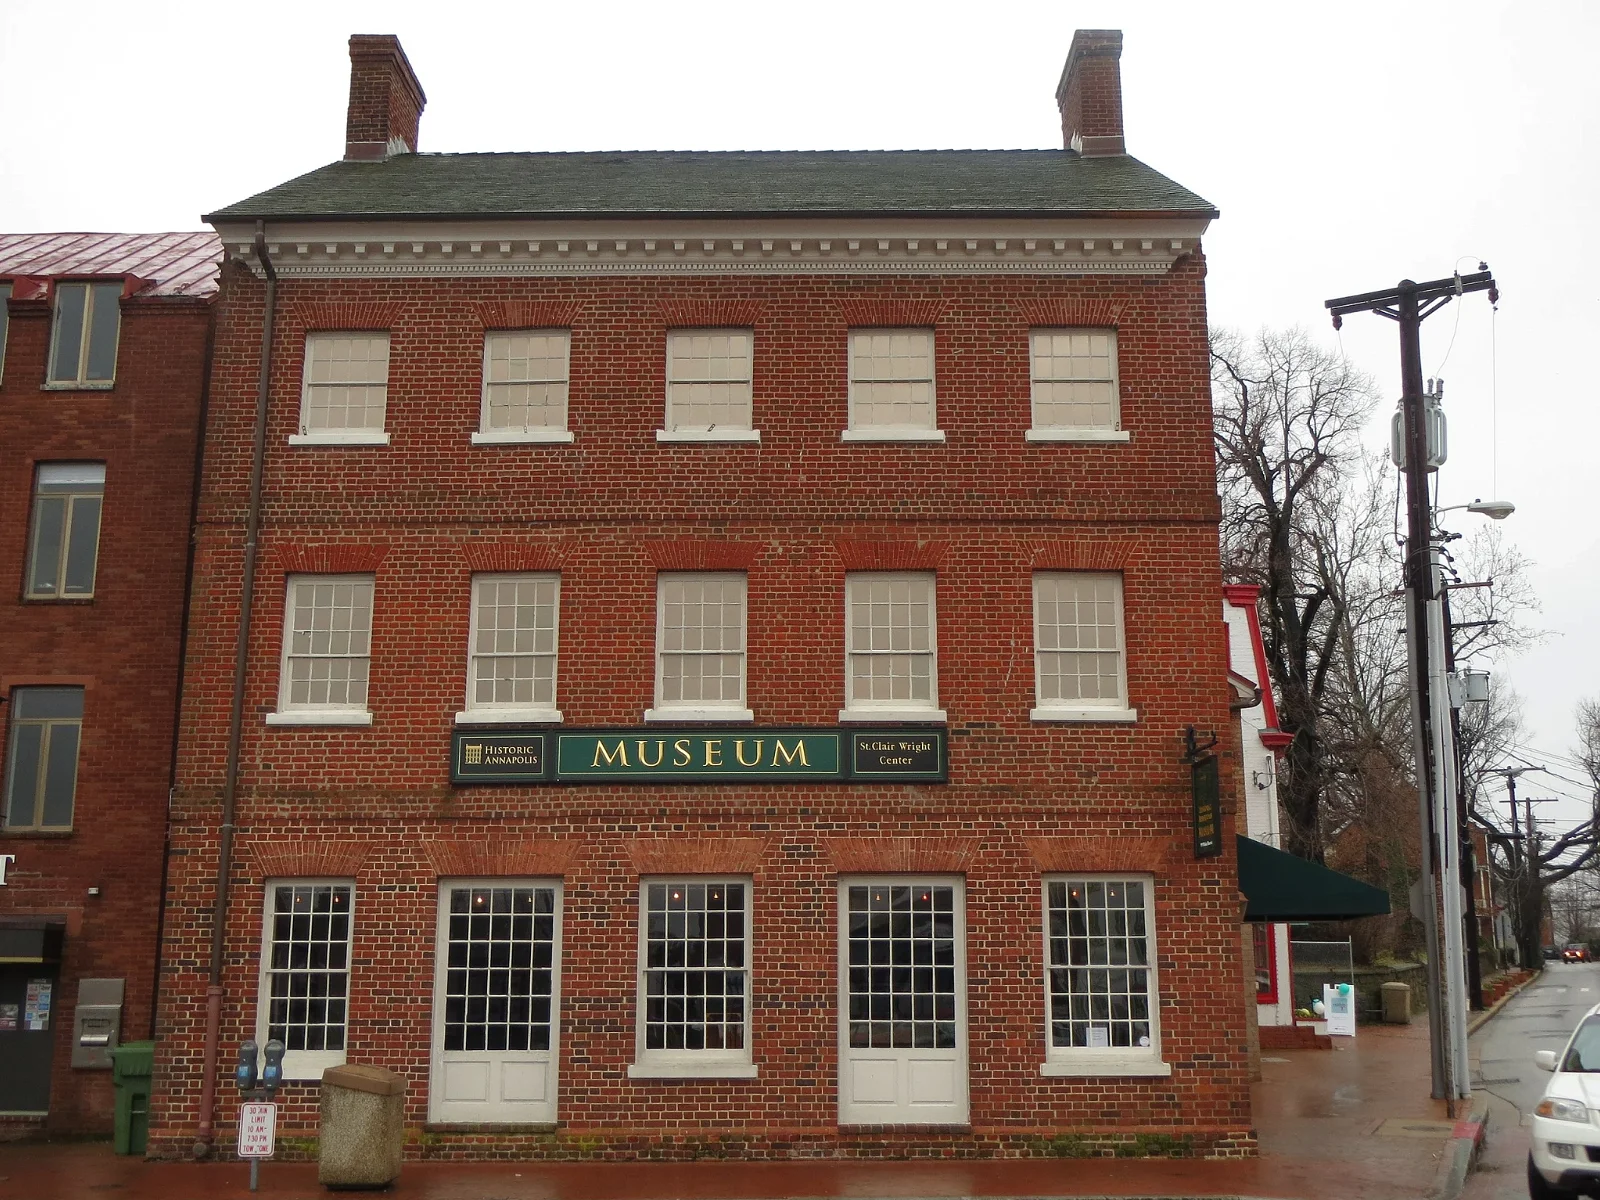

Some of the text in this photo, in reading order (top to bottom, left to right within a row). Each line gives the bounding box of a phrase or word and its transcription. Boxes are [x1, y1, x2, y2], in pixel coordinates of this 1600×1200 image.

[485, 746, 534, 755] HISTORIC
[899, 741, 931, 753] Wright
[590, 739, 811, 767] MUSEUM
[484, 756, 538, 765] ANNAPOLIS
[879, 755, 913, 765] Center
